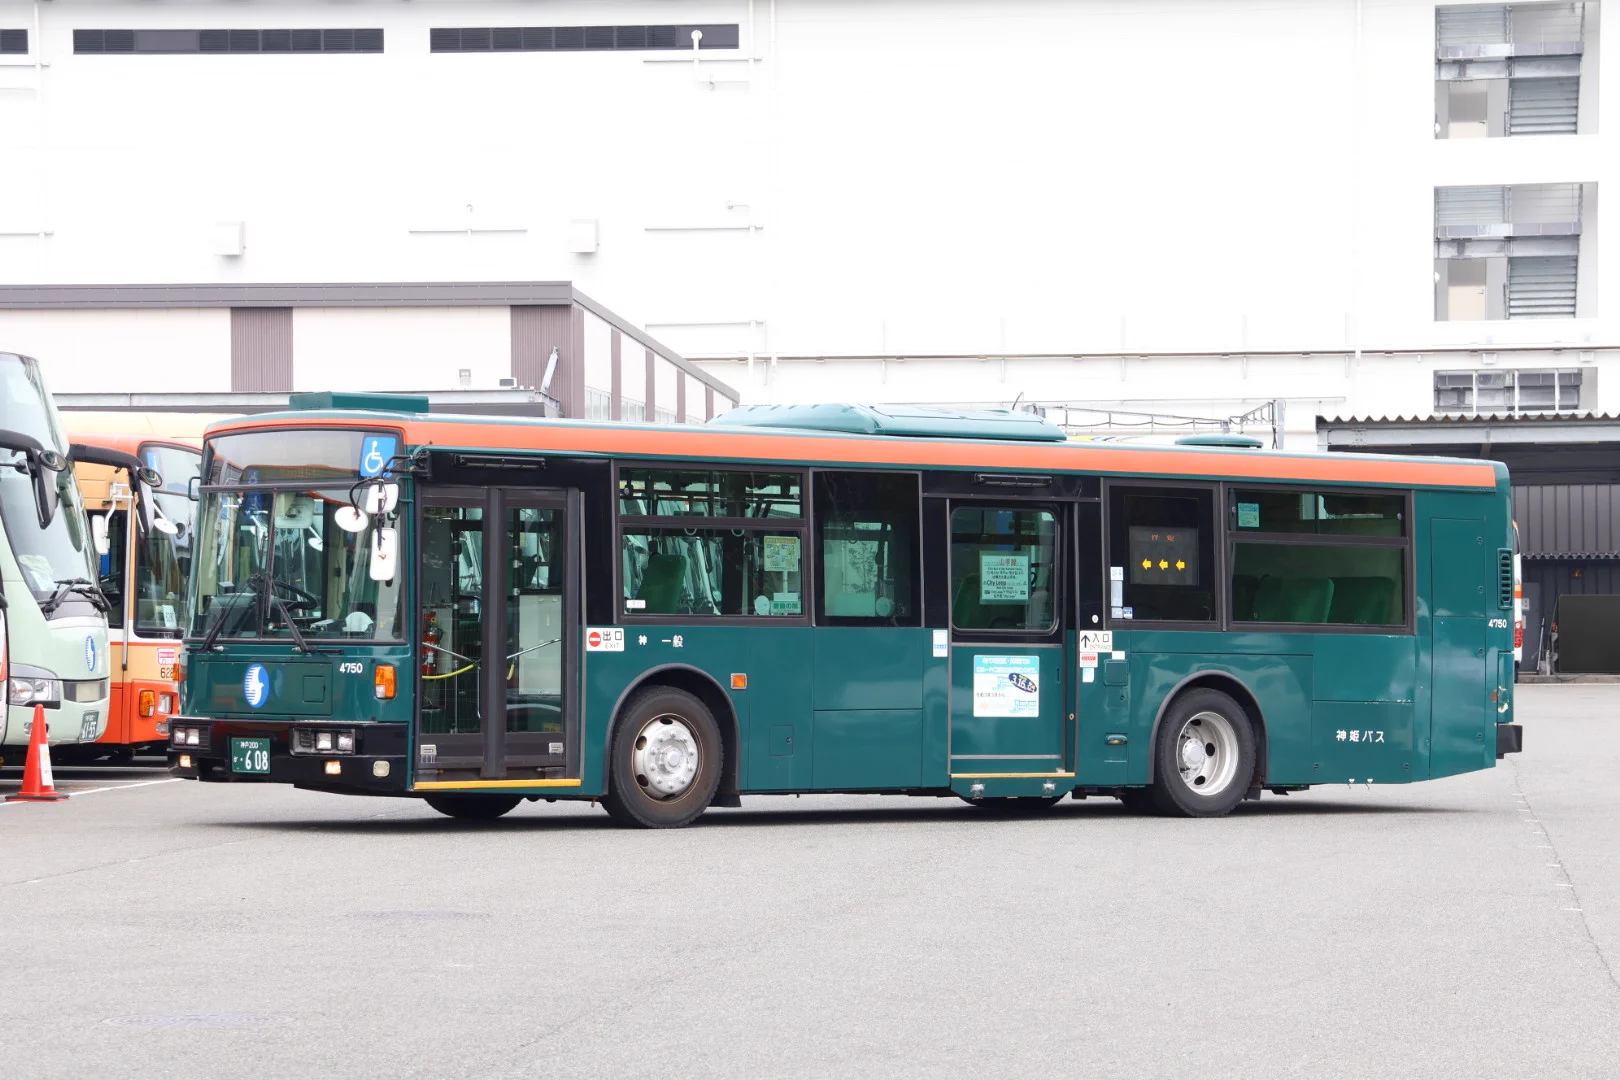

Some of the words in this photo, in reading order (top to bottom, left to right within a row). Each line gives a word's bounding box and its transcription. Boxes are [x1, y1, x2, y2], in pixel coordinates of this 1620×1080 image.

[1488, 618, 1507, 628] 4750
[602, 630, 622, 641] 出口
[1092, 632, 1109, 643] 入口
[339, 662, 363, 674] 4750
[1335, 729, 1385, 743] 神姫バス
